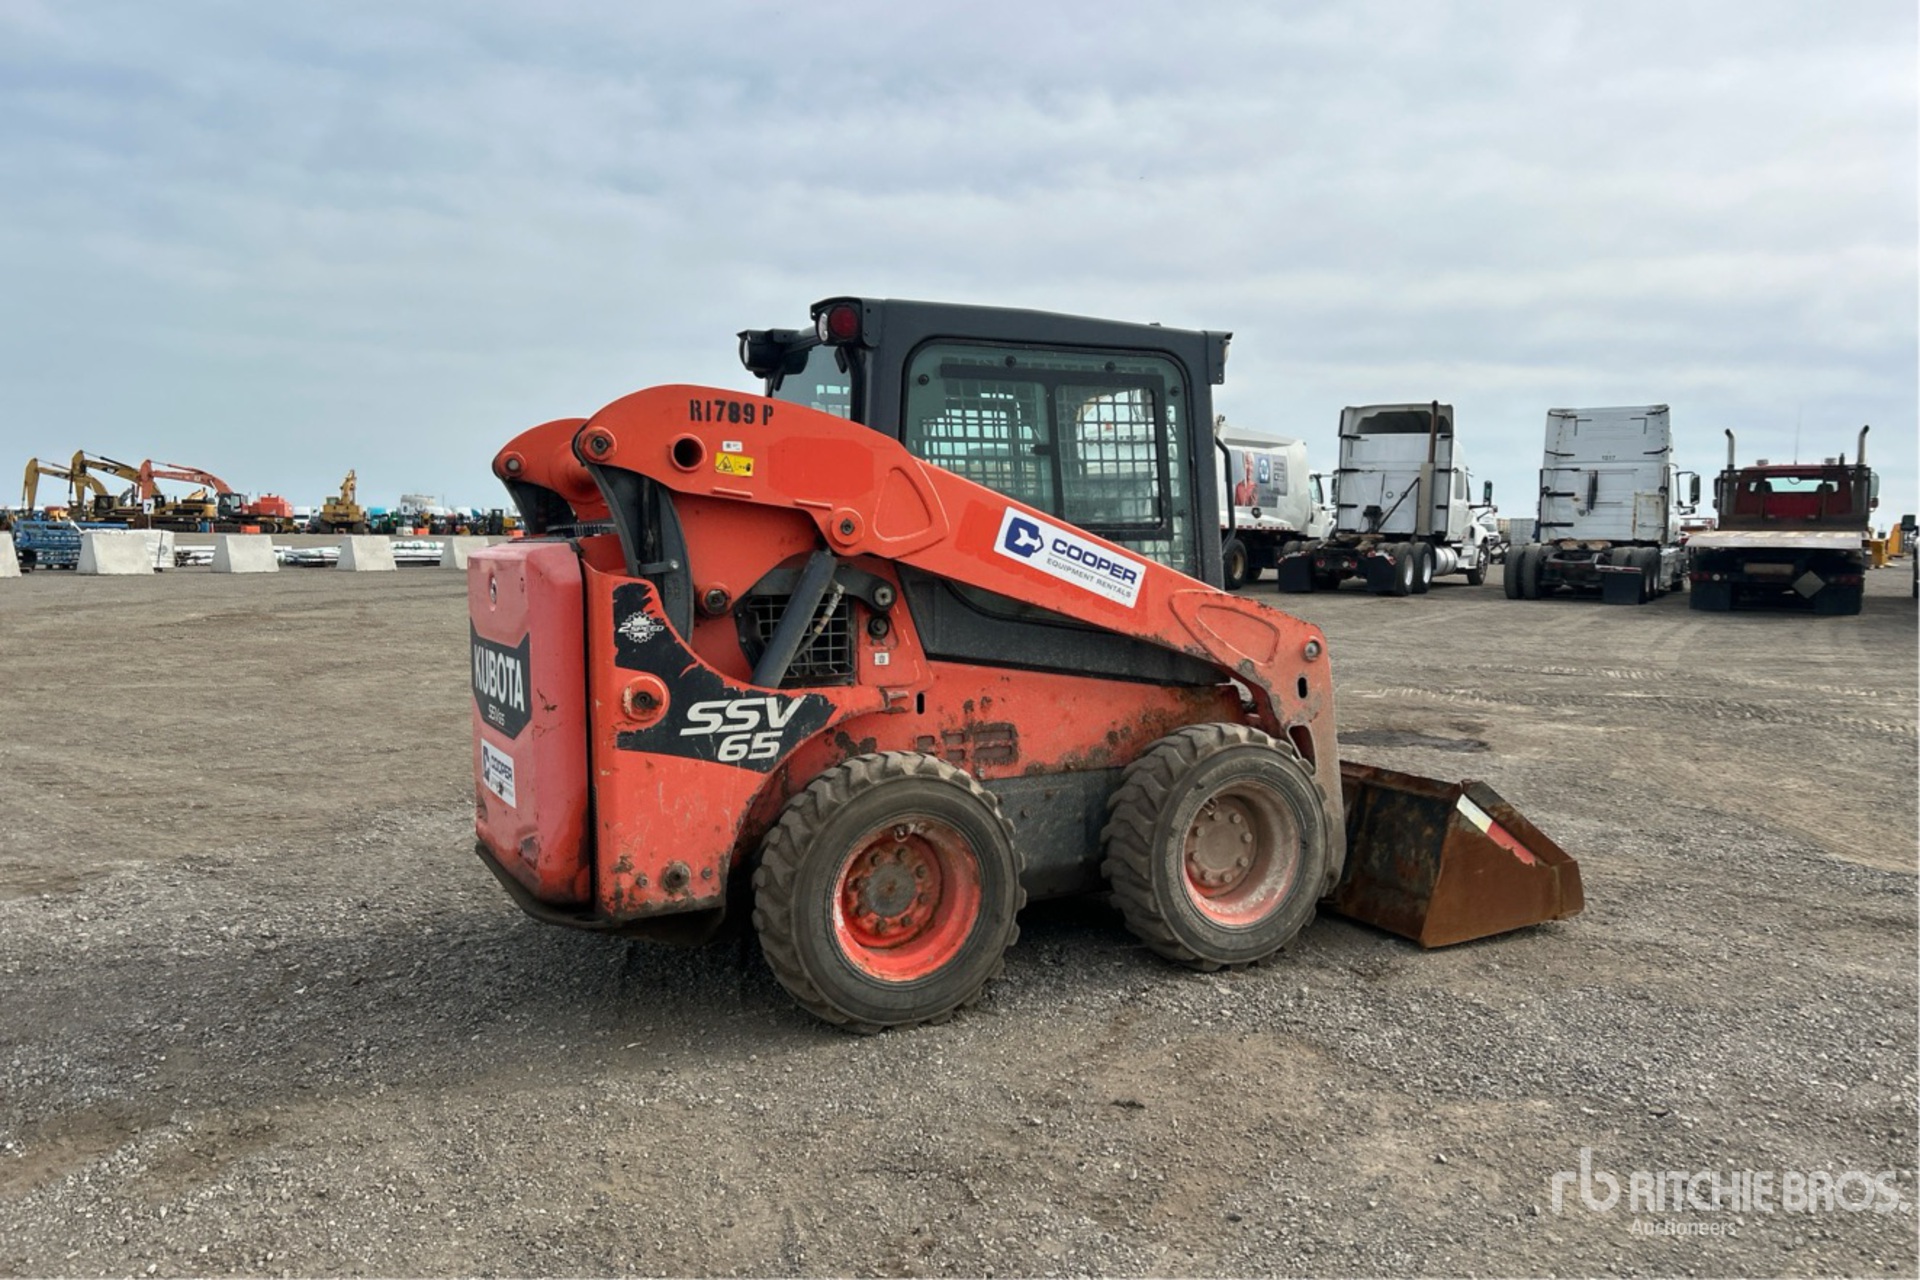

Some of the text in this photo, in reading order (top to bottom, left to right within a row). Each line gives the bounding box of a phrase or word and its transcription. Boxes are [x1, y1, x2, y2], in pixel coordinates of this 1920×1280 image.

[690, 399, 774, 425] R1789 P
[1046, 557, 1132, 599] EQUIPMENT RENTALS
[1051, 538, 1138, 584] COOPER
[474, 644, 525, 712] KUBOTA
[680, 694, 807, 736] SSV
[717, 730, 784, 762] 65
